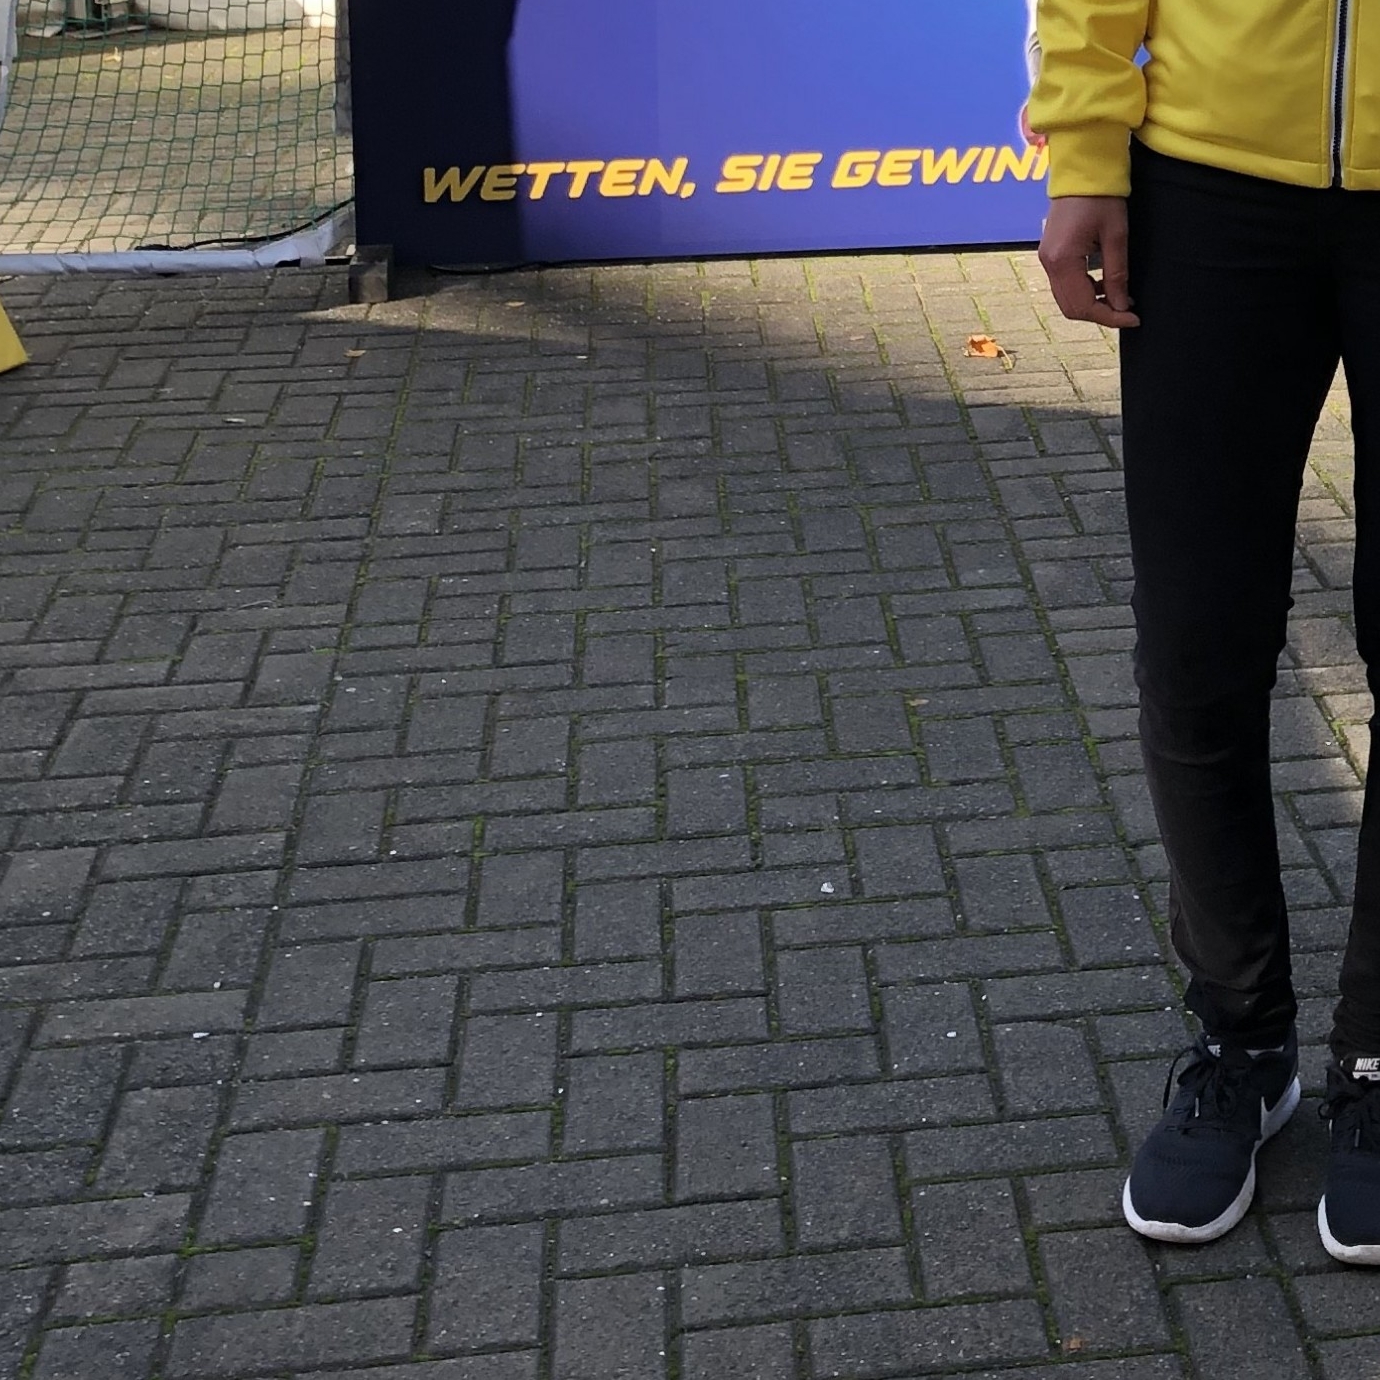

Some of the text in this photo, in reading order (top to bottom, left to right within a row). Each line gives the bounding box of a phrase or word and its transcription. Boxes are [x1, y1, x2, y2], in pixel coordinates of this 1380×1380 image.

[423, 157, 697, 203] WETTEN,
[715, 152, 823, 193] SIE
[1354, 1057, 1380, 1071] NIKE
